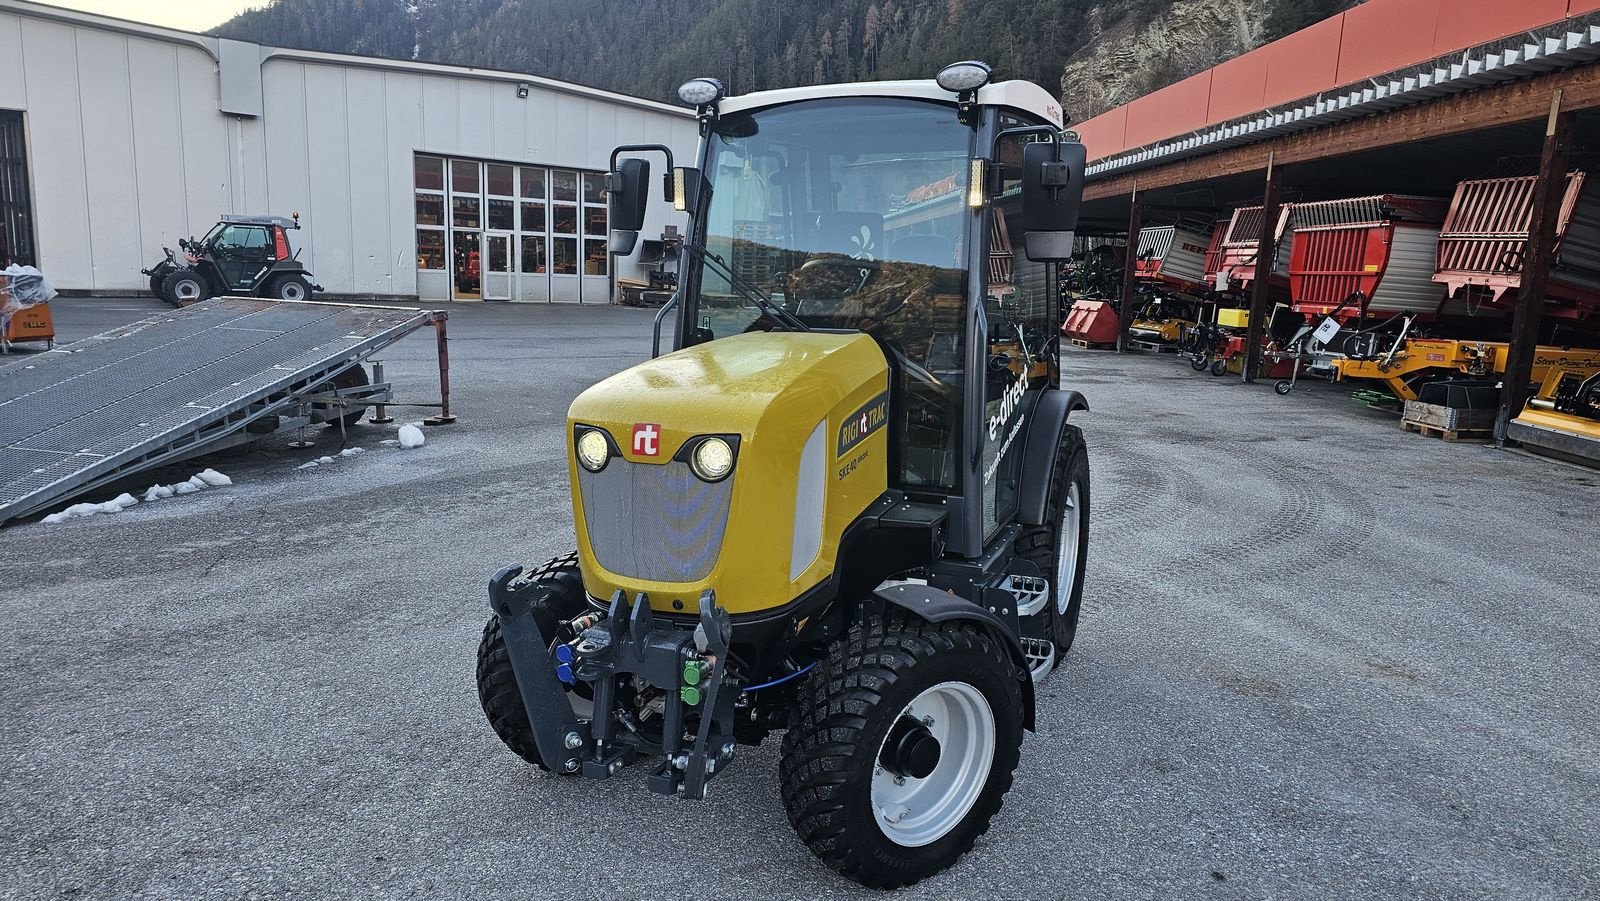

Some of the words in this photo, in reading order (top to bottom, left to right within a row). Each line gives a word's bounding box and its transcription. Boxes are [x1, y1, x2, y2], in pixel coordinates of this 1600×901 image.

[989, 363, 1029, 441] e-direct
[634, 424, 658, 455] rt
[842, 419, 858, 447] RIGI
[868, 401, 885, 428] TRAC
[838, 463, 850, 481] SKE
[850, 458, 858, 471] 40
